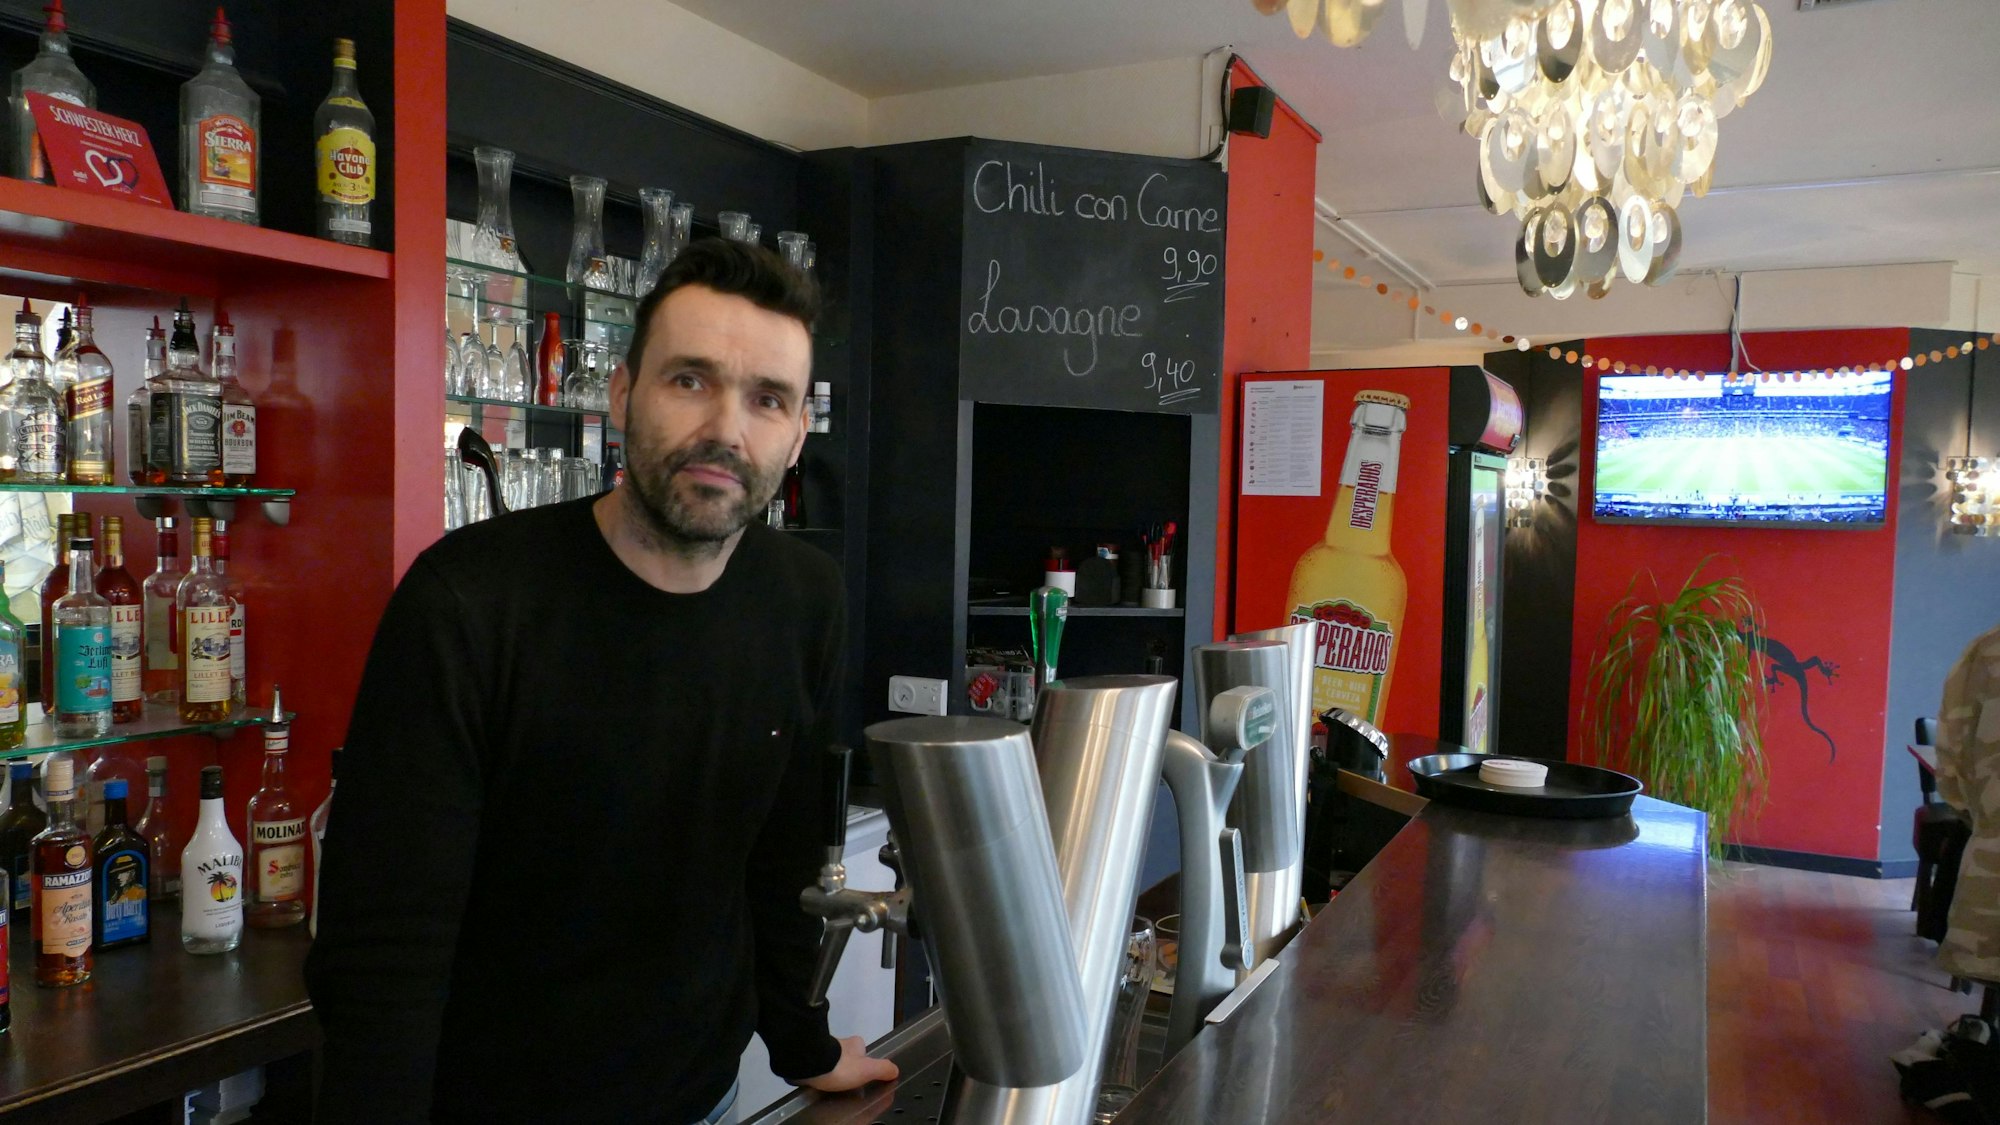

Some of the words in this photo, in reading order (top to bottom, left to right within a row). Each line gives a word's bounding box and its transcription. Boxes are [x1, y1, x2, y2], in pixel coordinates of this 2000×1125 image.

[49, 105, 116, 139] SCHWESTER
[204, 131, 252, 153] SIERRA
[329, 148, 371, 165] Havana
[338, 162, 364, 176] Club
[973, 160, 1065, 216] Chili
[1075, 194, 1128, 220] con
[1137, 173, 1221, 232] Carne
[1161, 247, 1217, 282] 9,90
[968, 259, 1142, 377] Lasagne
[1141, 352, 1195, 393] 9,40
[223, 412, 236, 423] JIM
[224, 438, 254, 447] BOURBON
[1350, 461, 1382, 529] DESPERADOS
[190, 609, 230, 624] LILLE
[1290, 615, 1392, 672] PERADOS
